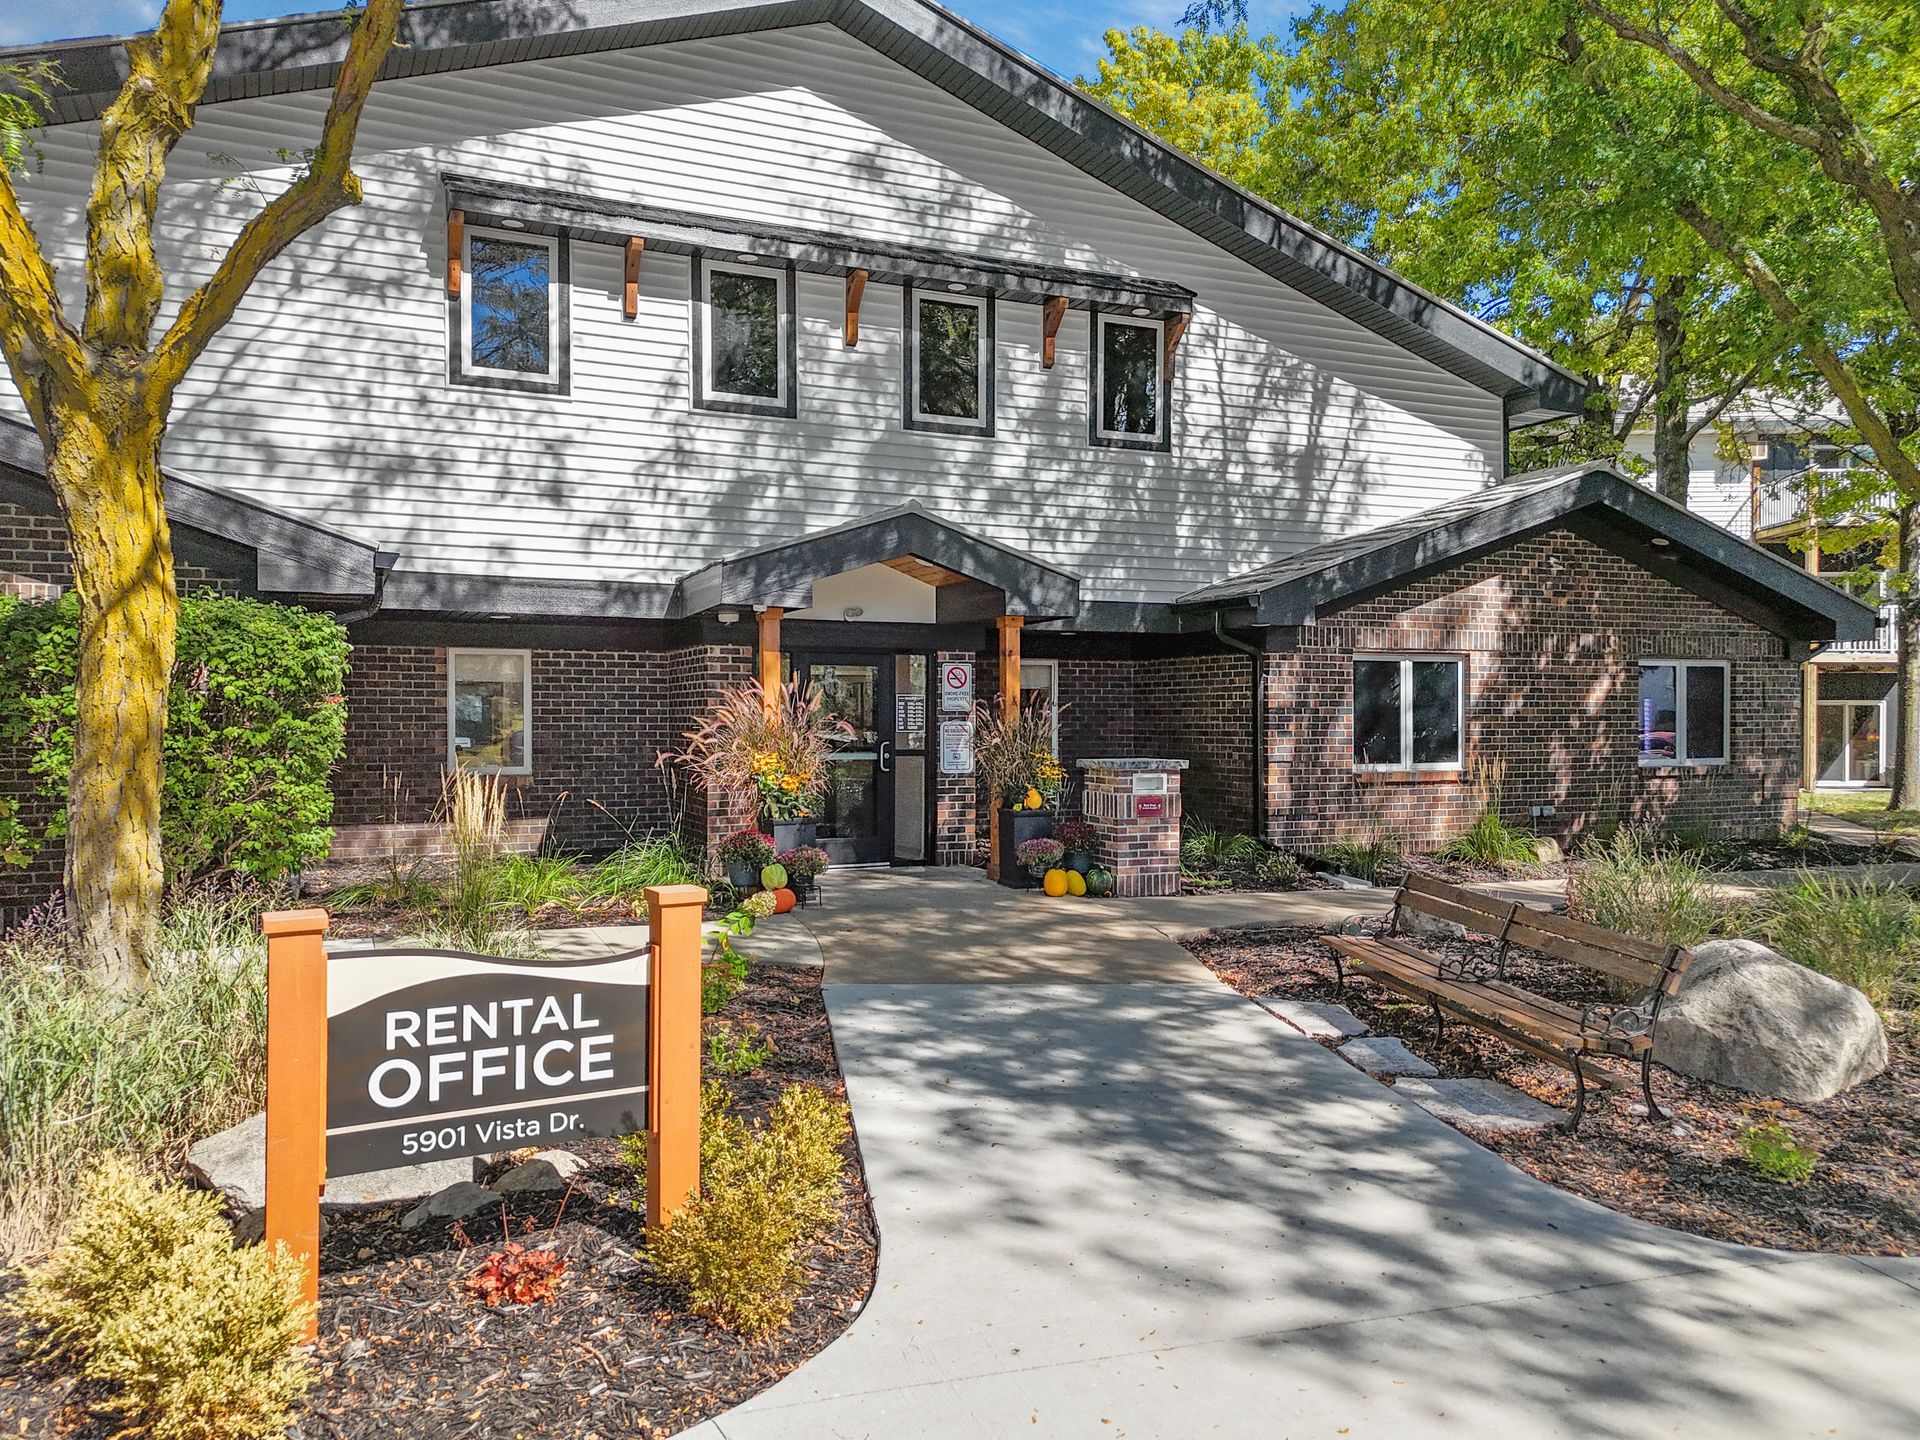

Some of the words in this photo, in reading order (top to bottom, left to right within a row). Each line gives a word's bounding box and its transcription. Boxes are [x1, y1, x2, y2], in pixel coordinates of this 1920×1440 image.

[385, 992, 600, 1051] RENTAL
[368, 1033, 615, 1108] OFFICE
[401, 1125, 466, 1155] 5901
[475, 1116, 541, 1145] Vista
[549, 1112, 585, 1133] Dr.
